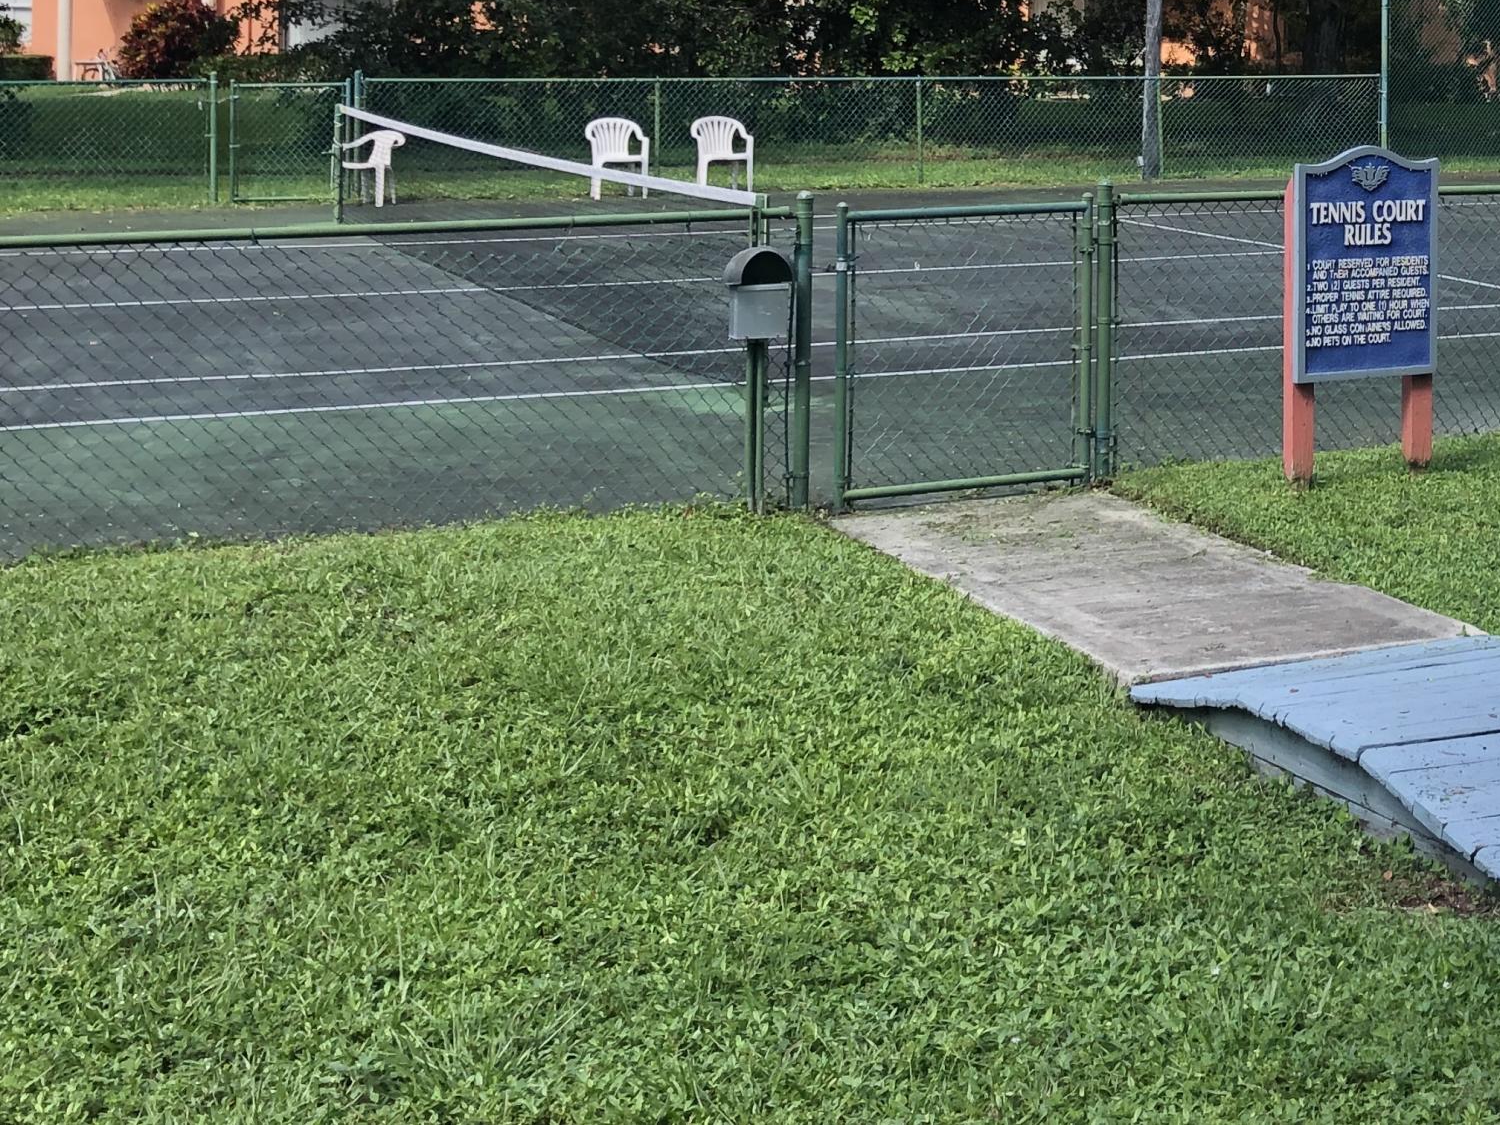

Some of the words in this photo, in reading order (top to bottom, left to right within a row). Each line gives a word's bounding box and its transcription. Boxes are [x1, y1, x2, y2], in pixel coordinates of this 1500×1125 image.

[1310, 201, 1365, 224] TENNIS
[1372, 199, 1426, 222] COURT
[1344, 223, 1392, 246] RULES
[1312, 259, 1336, 270] COURT
[1338, 257, 1374, 269] RESERVED
[1376, 257, 1390, 267] FOR
[1392, 255, 1429, 267] RESIDENTS
[1312, 270, 1328, 280] AND
[1351, 266, 1399, 278] ACCOMPANIED
[1313, 281, 1329, 292] TWO
[1331, 279, 1341, 292] (2)
[1343, 278, 1370, 290] GUESTS
[1372, 277, 1386, 288] PER
[1388, 276, 1422, 287] RESIDENT.
[1313, 292, 1339, 303] PROPER
[1341, 290, 1366, 301] TENNIS
[1367, 289, 1391, 300] ATTIRE
[1392, 287, 1428, 299] REQUIRED.
[1312, 303, 1330, 314] LIMIT
[1331, 303, 1348, 314] PLAY
[1349, 302, 1360, 313] TO
[1361, 301, 1377, 312] ONE
[1389, 299, 1408, 310] HOUR
[1410, 298, 1430, 309] WHEN
[1312, 314, 1339, 325] OTHERS
[1341, 312, 1356, 323] ARE
[1357, 310, 1385, 322] WAITING
[1386, 309, 1401, 320] FOR
[1402, 308, 1428, 319] COURT.
[1311, 325, 1323, 336] NO
[1324, 324, 1348, 335] GLASS
[1393, 319, 1427, 331] ALLOWED.
[1311, 337, 1322, 348] NO
[1323, 335, 1341, 347] PETS
[1341, 335, 1353, 346] ON
[1353, 334, 1367, 345] THE
[1368, 332, 1392, 344] COURT.
